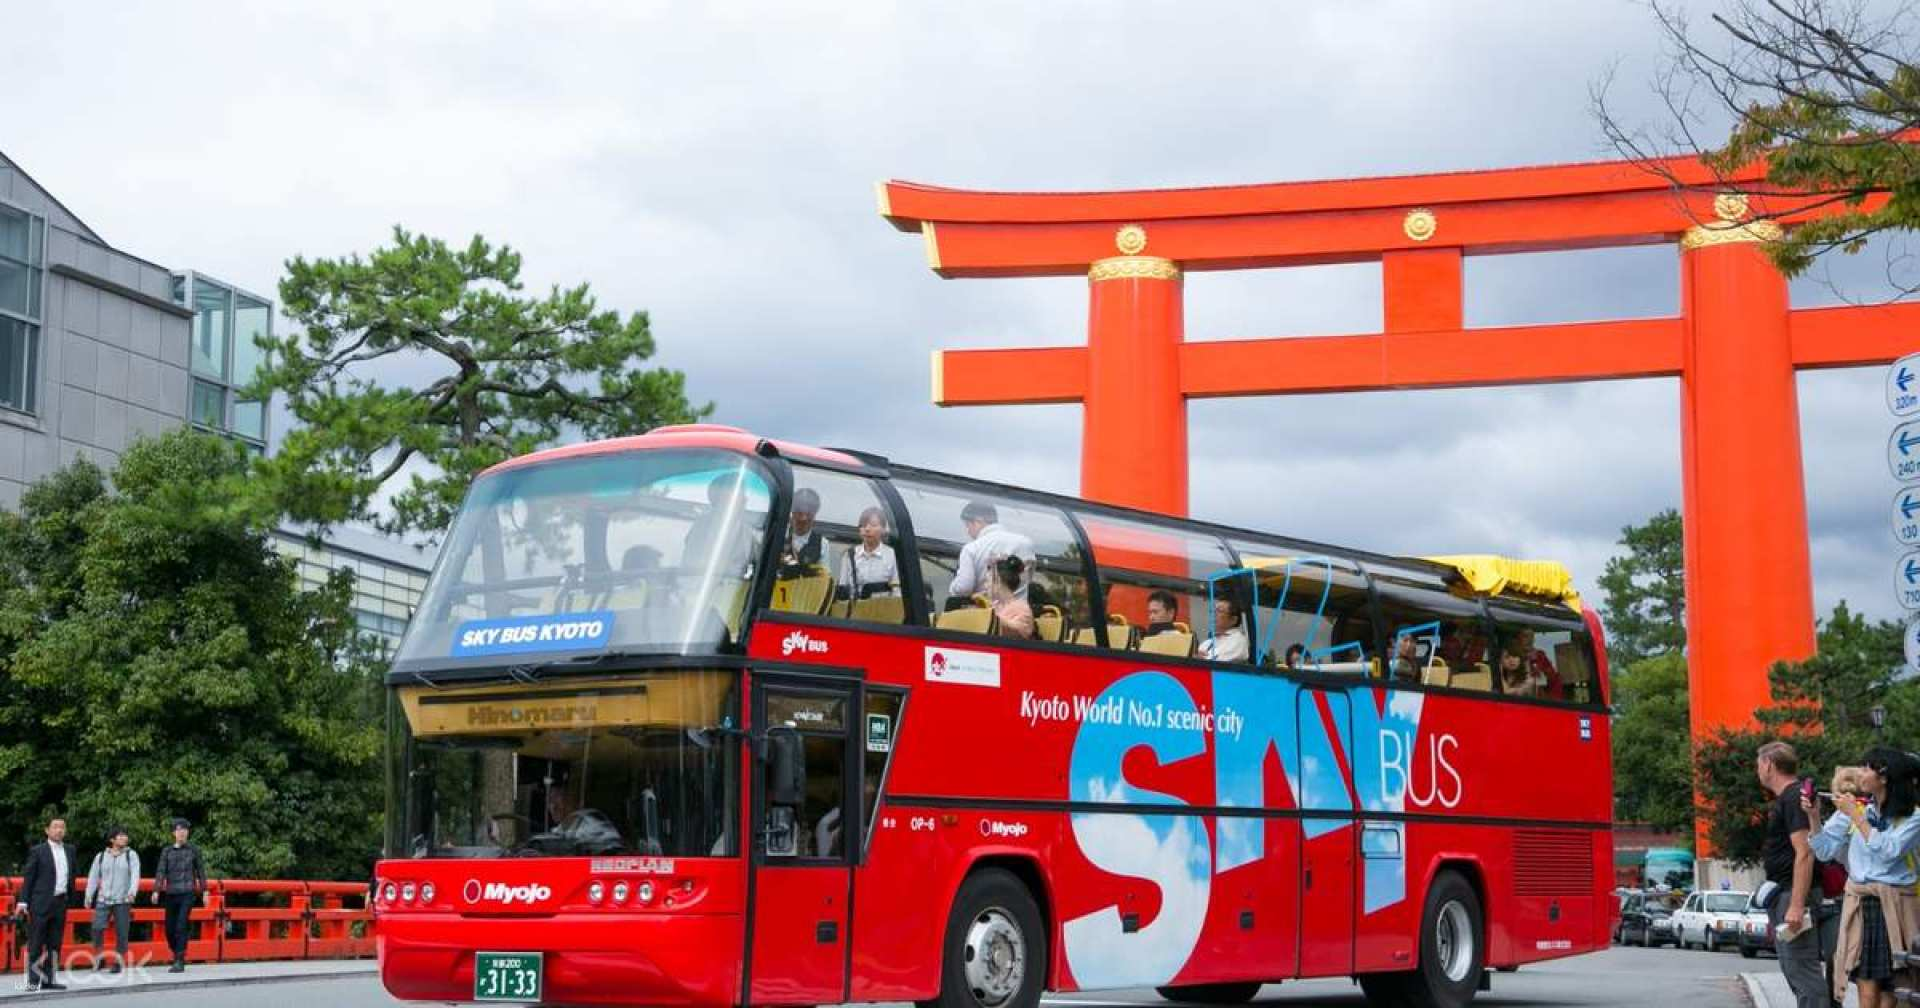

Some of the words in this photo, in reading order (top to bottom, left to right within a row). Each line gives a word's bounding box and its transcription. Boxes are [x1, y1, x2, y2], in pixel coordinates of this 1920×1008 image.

[461, 628, 500, 647] SKY
[499, 624, 539, 644] BUS
[539, 620, 603, 641] KYOTO
[782, 630, 809, 656] SKY
[808, 639, 829, 653] BUS
[466, 704, 598, 726] Hinomaru
[1020, 691, 1070, 727] Kyoto
[1073, 695, 1124, 725] World
[1128, 700, 1164, 729] No.1
[1167, 704, 1214, 732] scenic
[1217, 707, 1245, 742] city
[1379, 728, 1462, 809] BUS
[911, 817, 936, 831] OP-6
[991, 821, 1028, 837] Myojo
[484, 882, 551, 904] Myojo
[487, 969, 537, 996] 31-33
